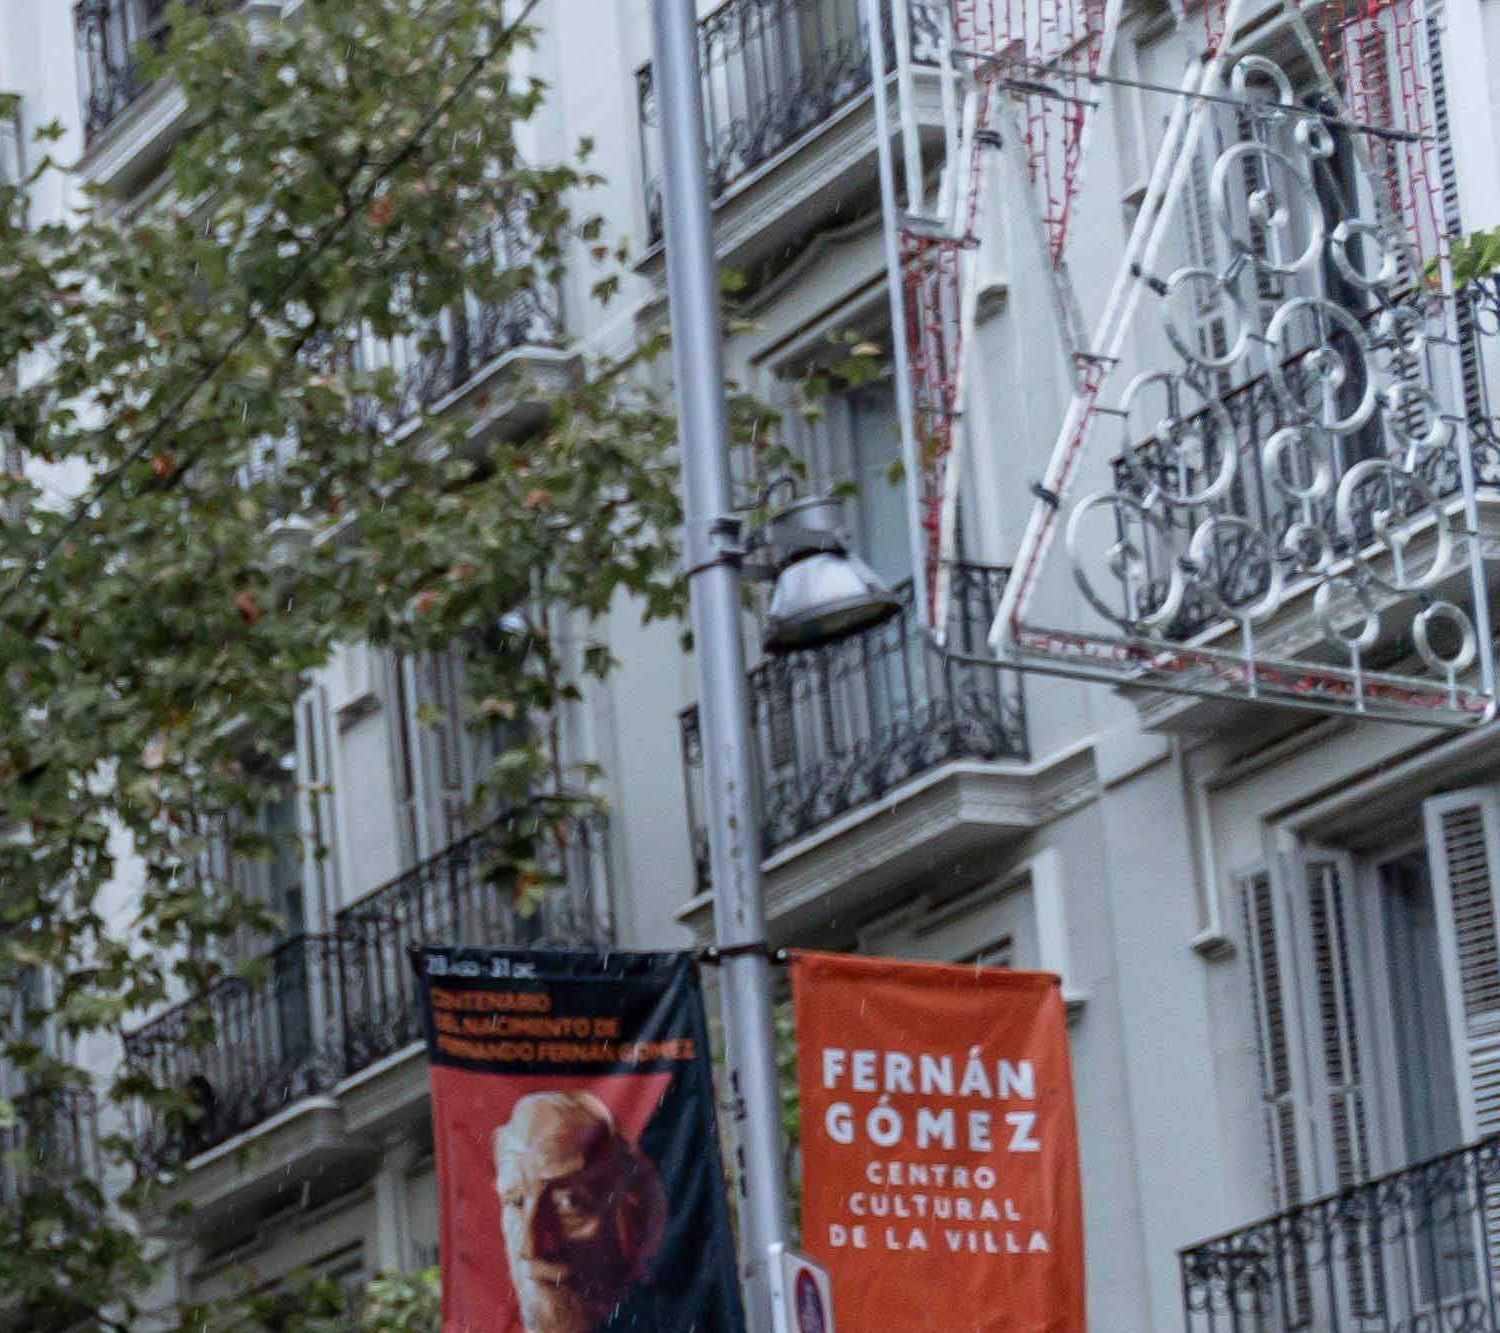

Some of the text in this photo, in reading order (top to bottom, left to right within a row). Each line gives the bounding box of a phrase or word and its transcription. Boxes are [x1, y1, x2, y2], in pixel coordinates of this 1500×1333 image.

[822, 1045, 1036, 1100] FERNÁN
[825, 1093, 1041, 1152] GÓMEZ
[866, 1161, 996, 1189] CENTRO
[850, 1192, 1021, 1221] CULTURAL
[829, 1224, 1050, 1253] DE LA VILLA
